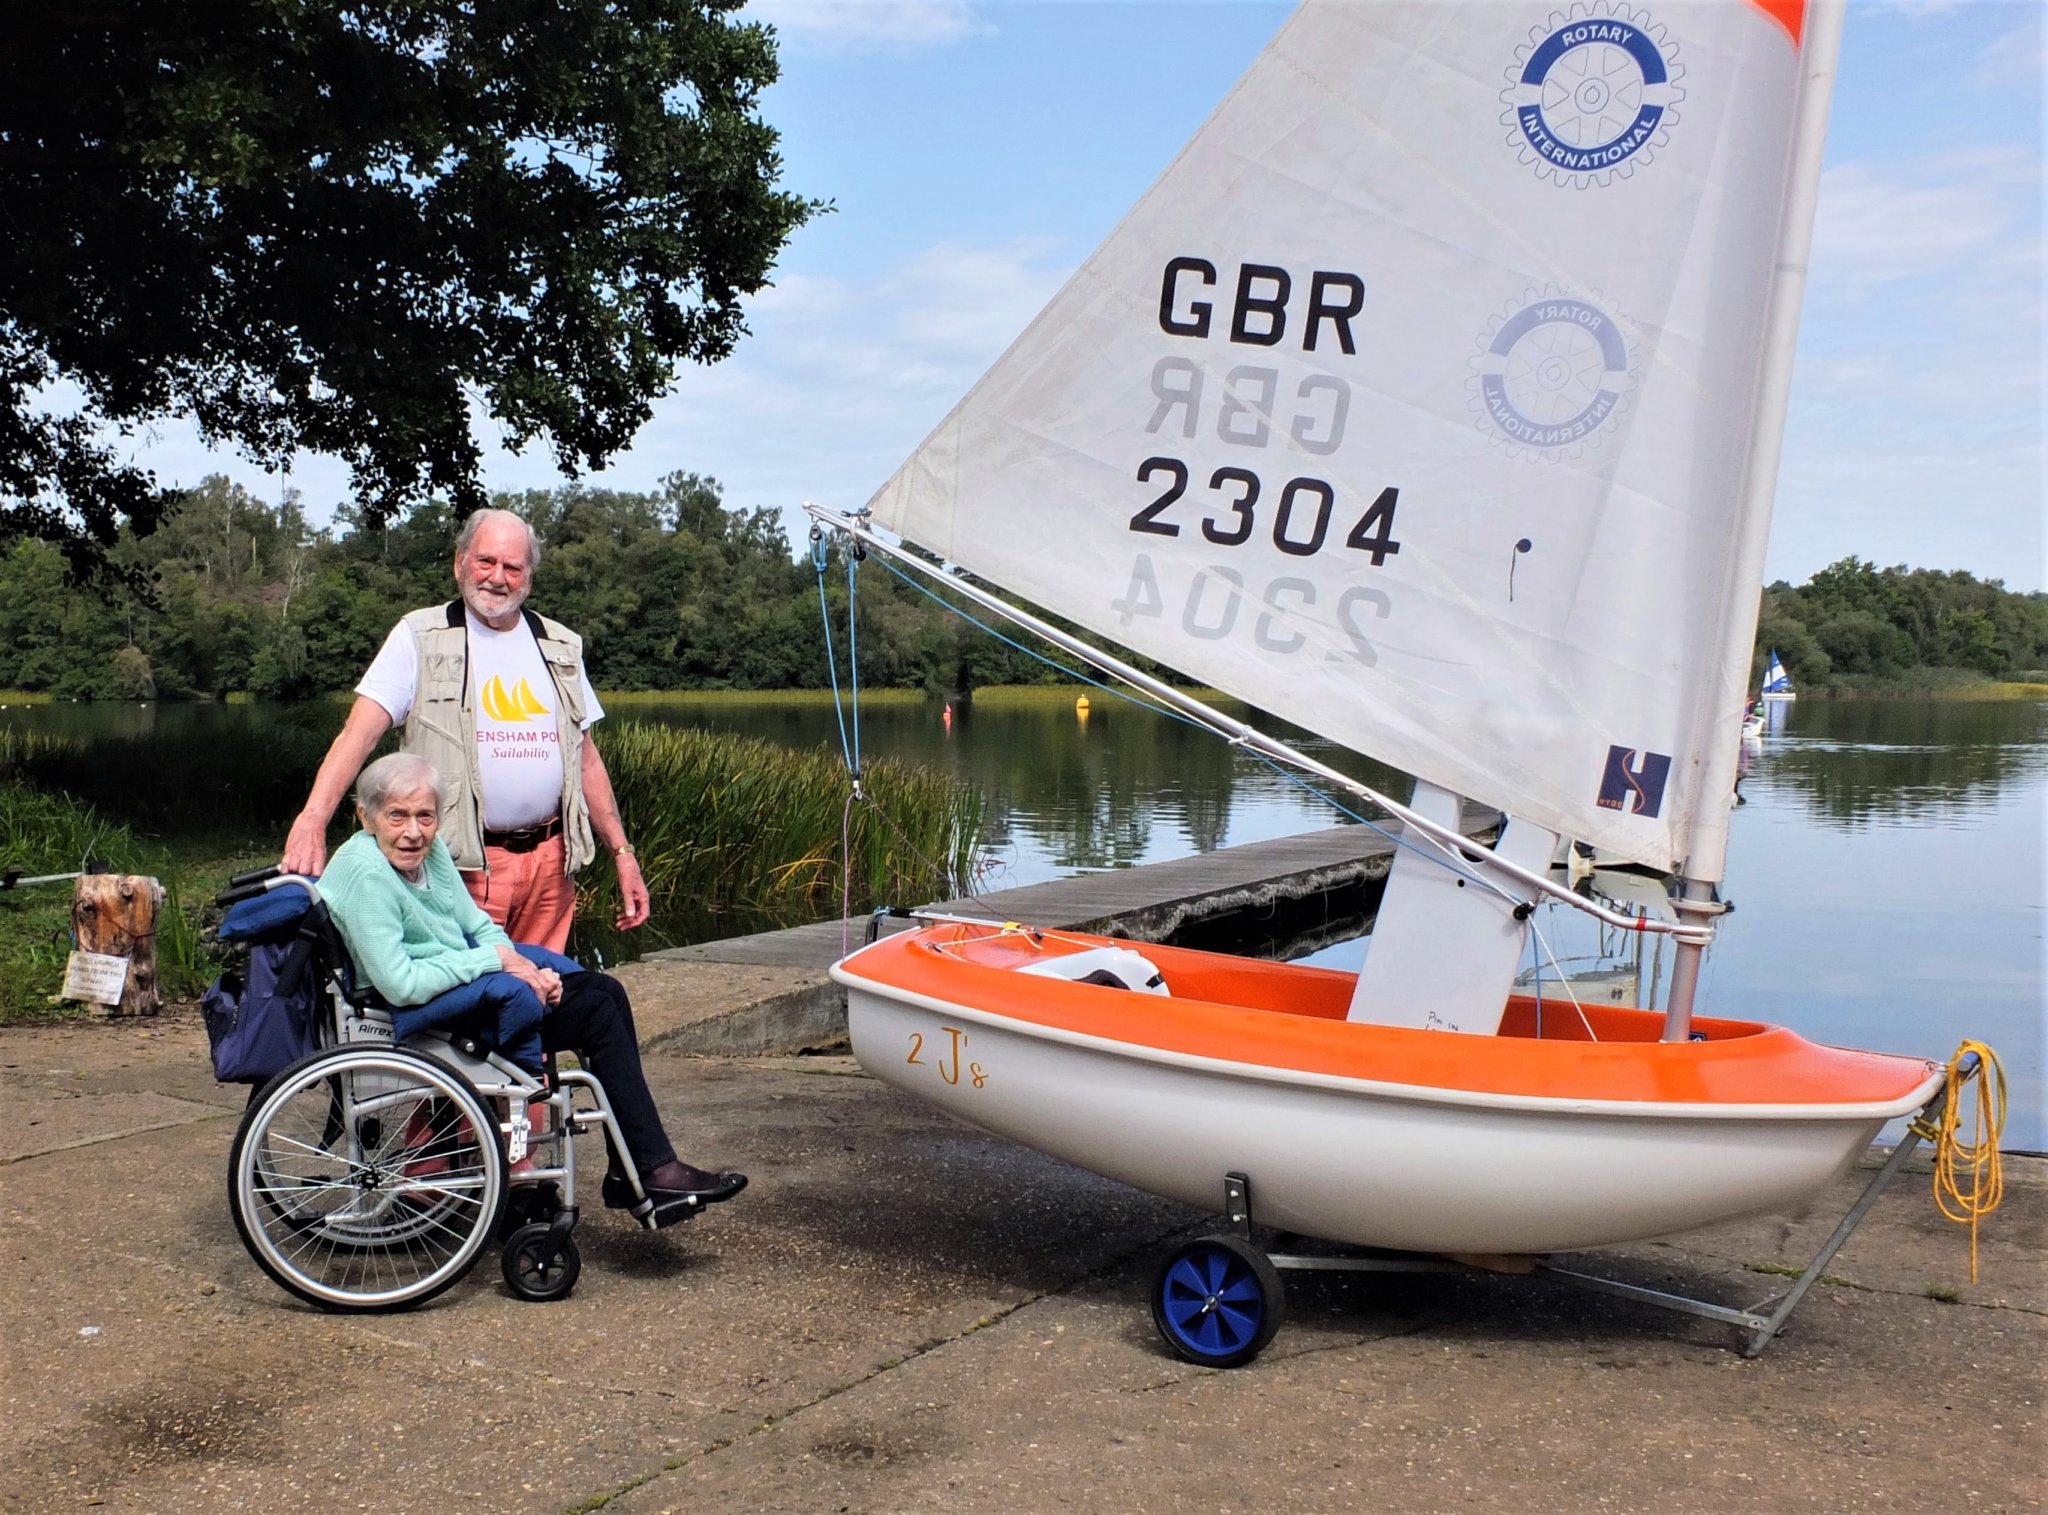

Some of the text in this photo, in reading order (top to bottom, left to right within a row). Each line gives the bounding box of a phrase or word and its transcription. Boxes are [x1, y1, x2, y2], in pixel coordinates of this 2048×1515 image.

[1561, 24, 1633, 48] ROTARY
[1523, 113, 1656, 169] INTERNATIONAL
[1158, 256, 1366, 356] GBR
[1129, 456, 1401, 567] 2304
[476, 731, 537, 742] ENSHAM
[491, 747, 550, 761] Sailability
[358, 1024, 393, 1037] Airrex
[906, 1026, 990, 1089] 2 J's
